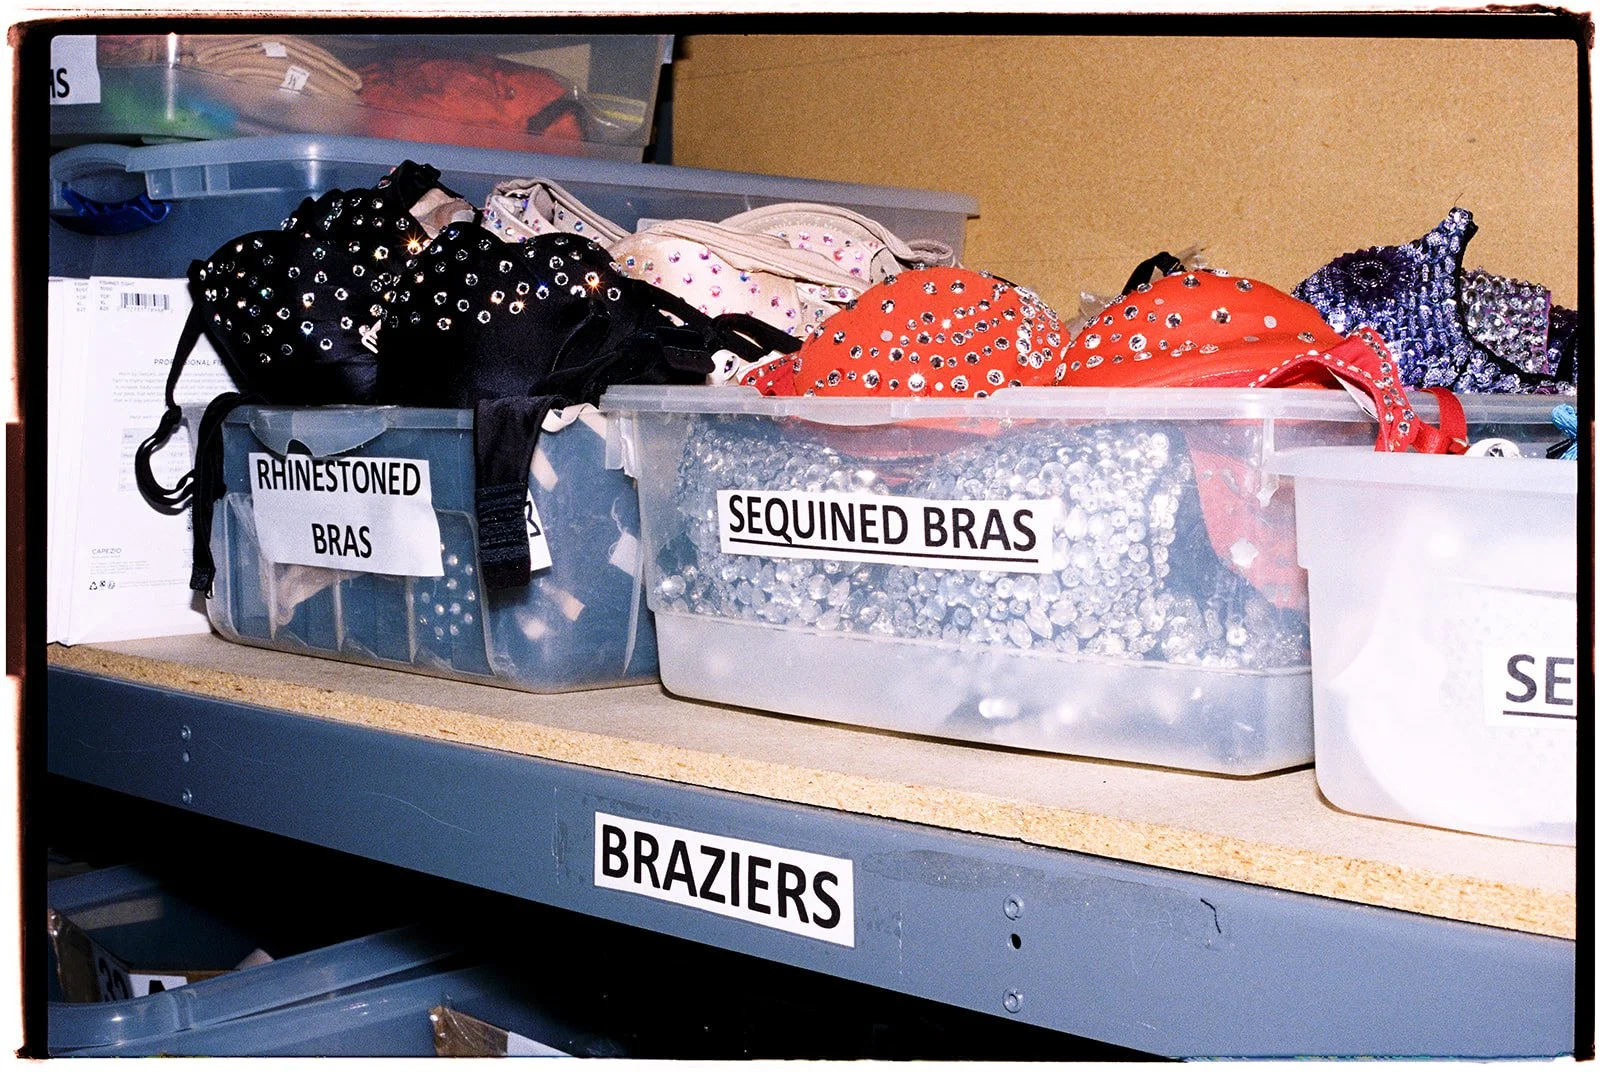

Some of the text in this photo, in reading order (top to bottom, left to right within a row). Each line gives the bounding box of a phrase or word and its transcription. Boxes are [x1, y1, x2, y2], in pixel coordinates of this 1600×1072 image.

[257, 459, 421, 496] RHINESTONED
[312, 523, 373, 559] BRAS
[729, 494, 1037, 551] SEQUINED BRAS
[1506, 654, 1575, 706] SE
[602, 824, 841, 929] BRAZIERS
